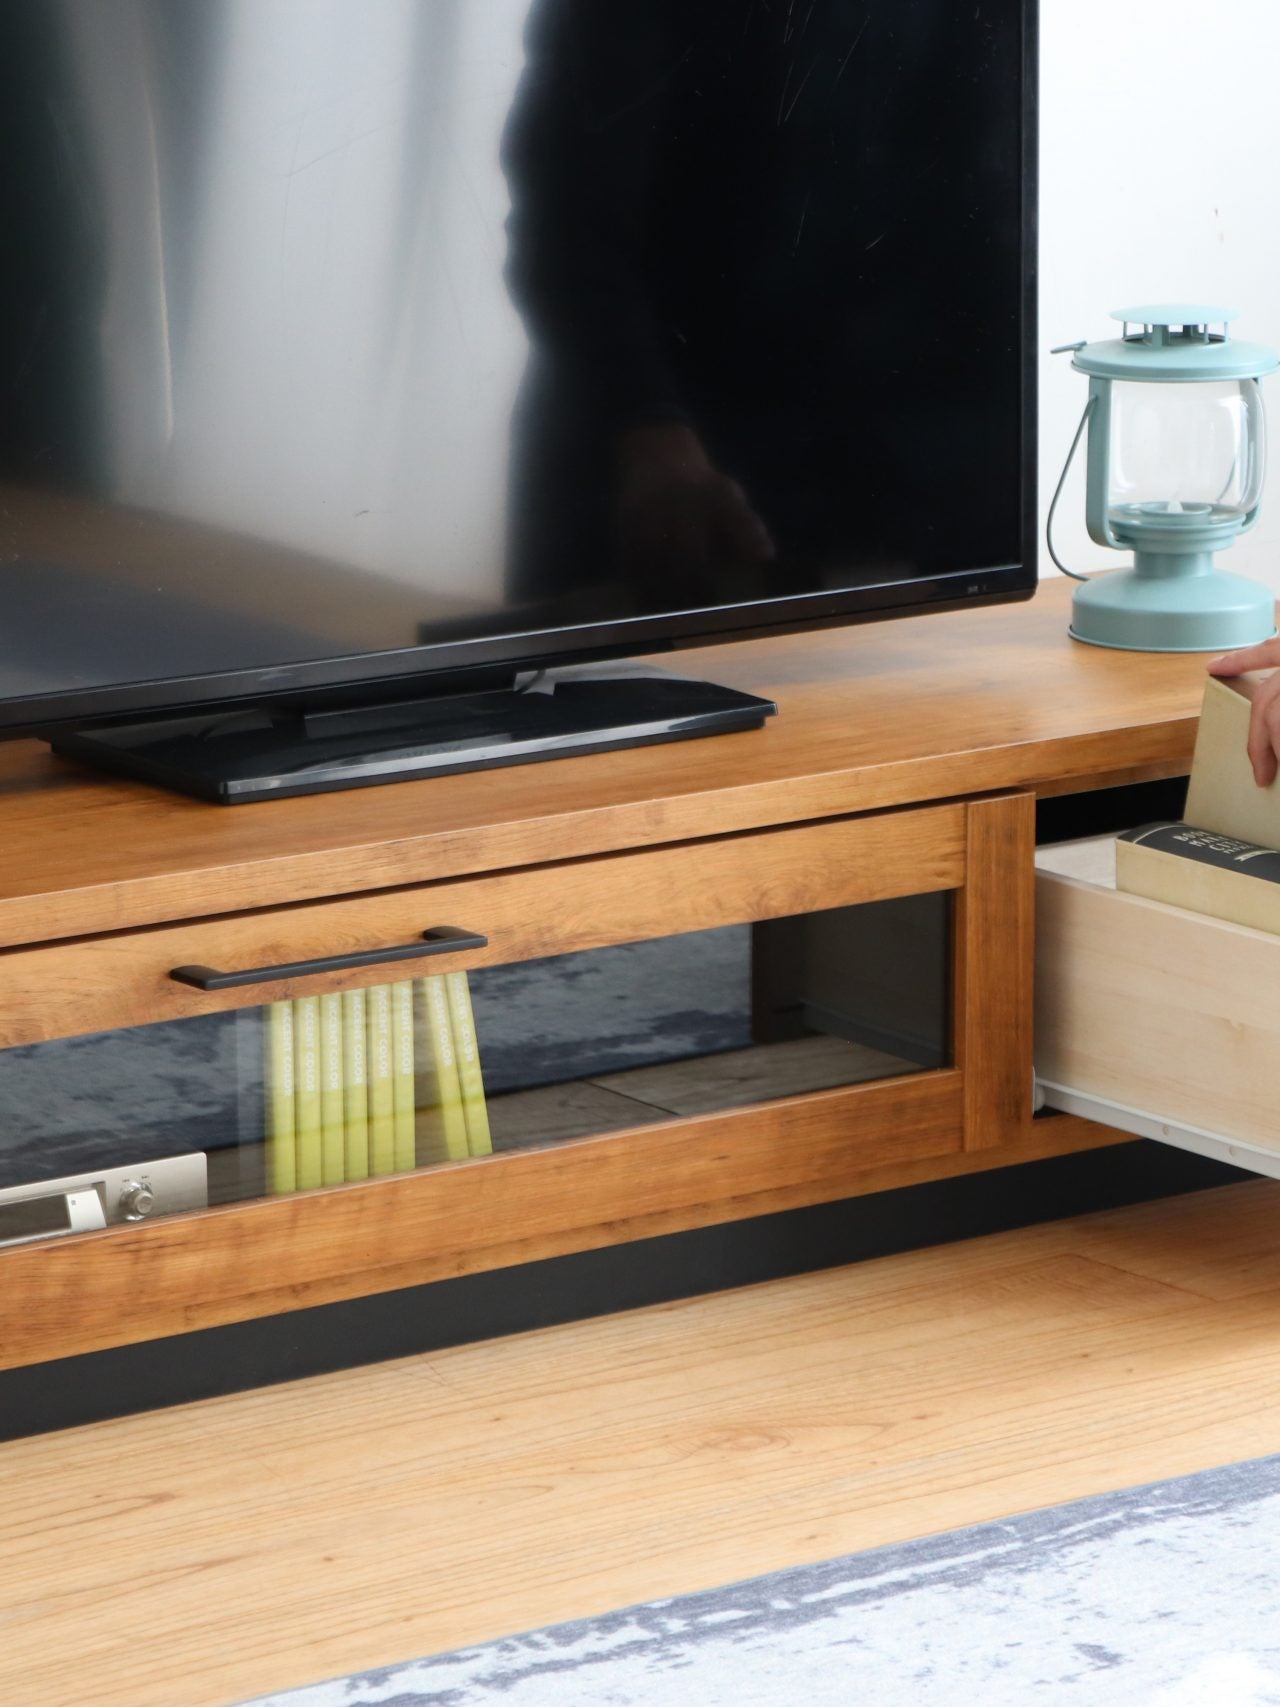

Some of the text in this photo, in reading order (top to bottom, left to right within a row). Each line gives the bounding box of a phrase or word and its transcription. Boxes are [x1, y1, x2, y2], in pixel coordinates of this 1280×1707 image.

[305, 1004, 315, 1092] ACCENT COLOR
[353, 996, 363, 1084] ACCENT COLOR
[379, 989, 388, 1078] ACCENT COLOR
[440, 1028, 453, 1067] COLOR
[330, 1049, 339, 1089] COLOR
[402, 1034, 411, 1074] COLOR
[284, 1056, 293, 1096] COLOR
